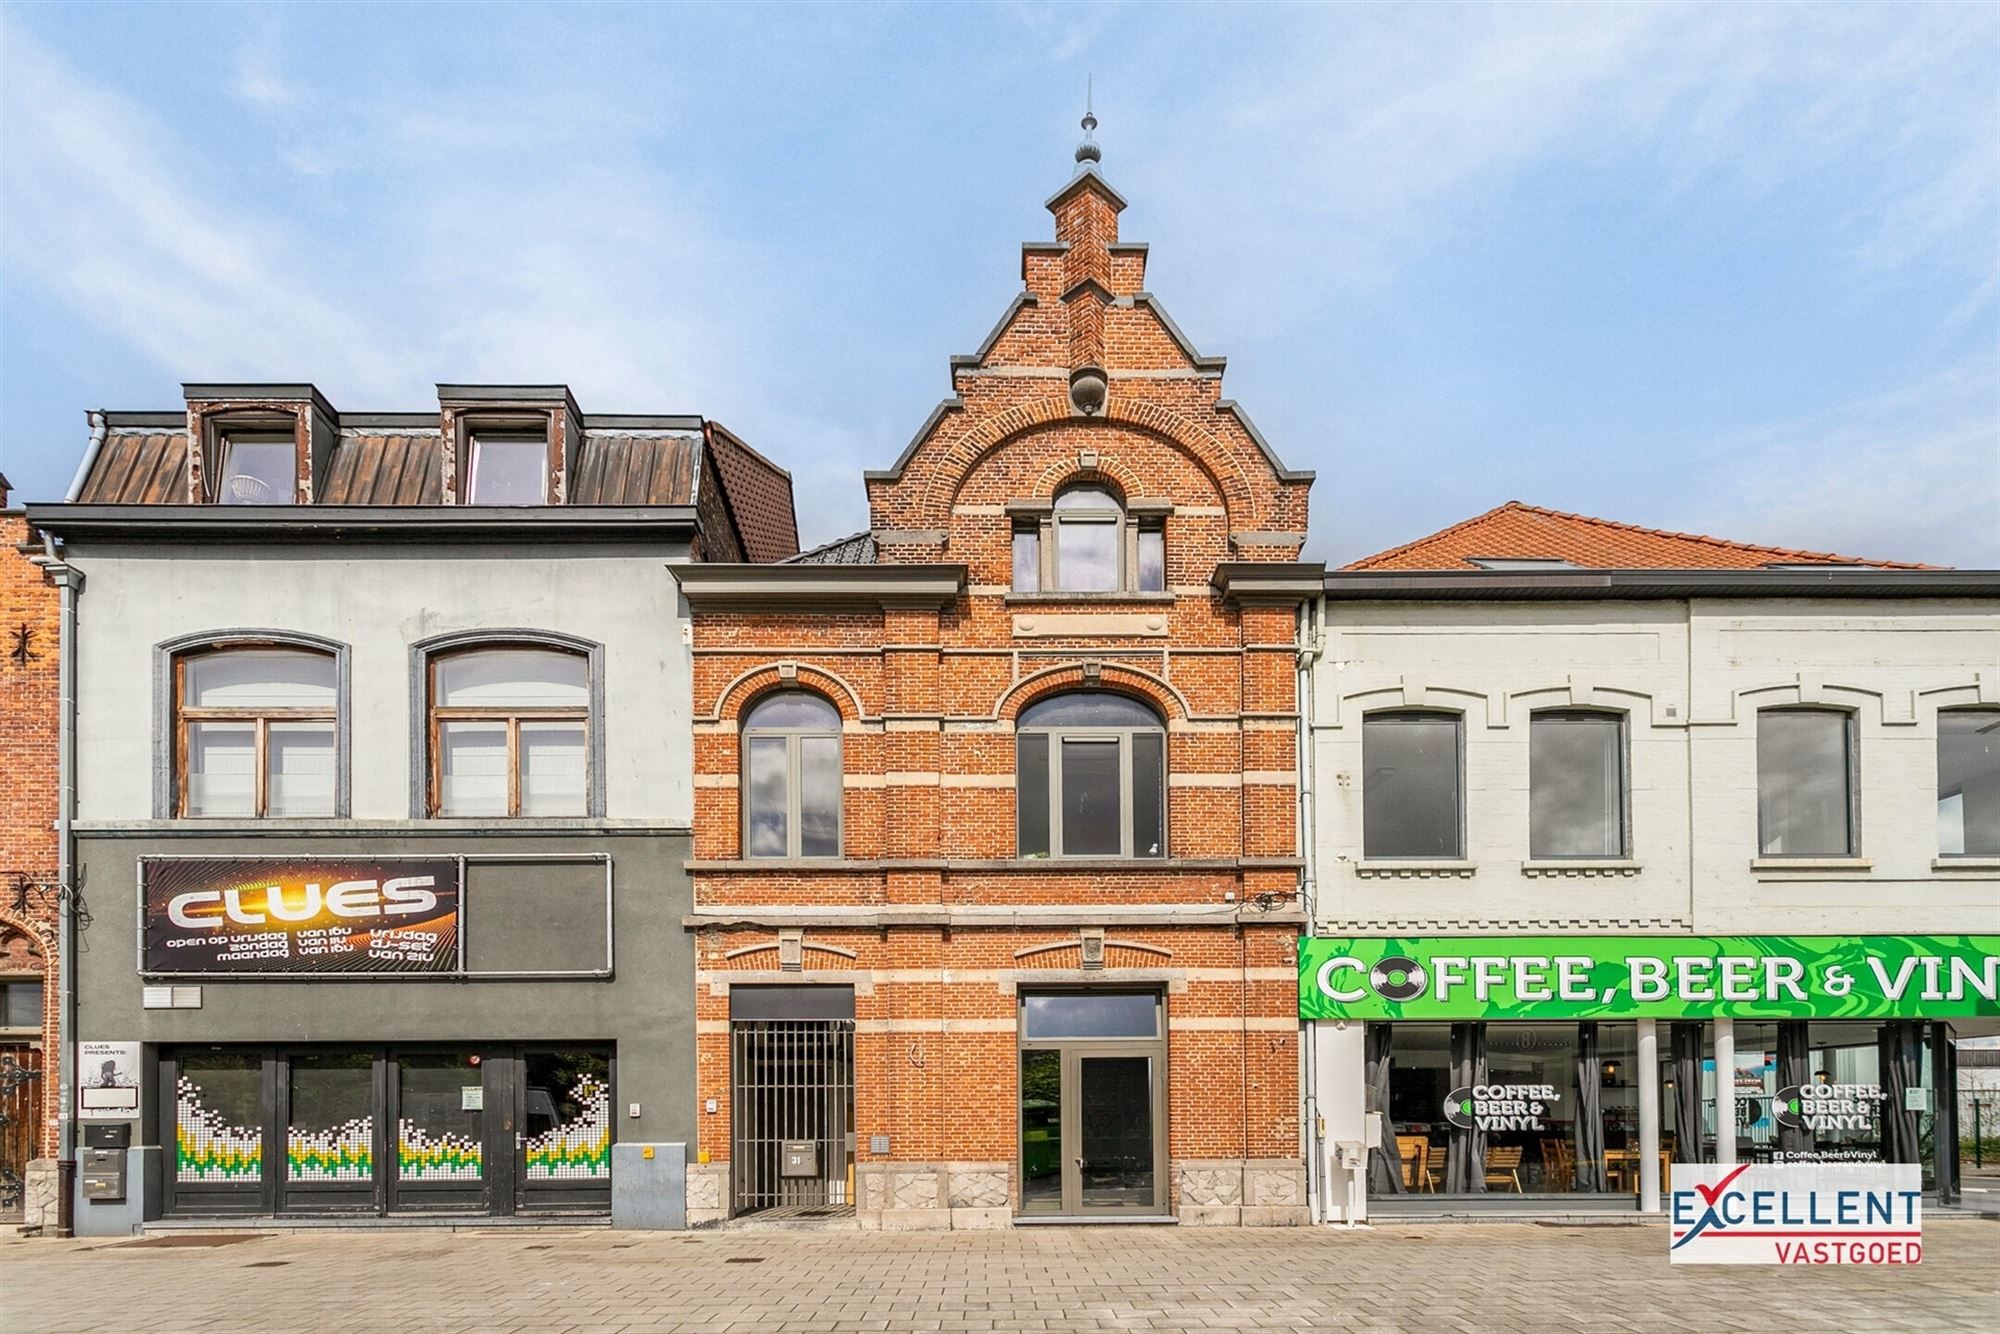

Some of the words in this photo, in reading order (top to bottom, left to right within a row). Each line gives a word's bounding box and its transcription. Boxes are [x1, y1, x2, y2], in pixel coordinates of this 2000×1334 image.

[167, 875, 437, 928] CLUES
[166, 938, 206, 948] open
[208, 935, 228, 946] op
[230, 931, 288, 943] vrijdag
[296, 929, 327, 938] van
[229, 940, 289, 951] zondag
[297, 937, 328, 946] van
[370, 928, 437, 944] vrijdag
[217, 949, 289, 961] maandag
[298, 945, 329, 955] van
[368, 949, 404, 960] van
[1316, 956, 1618, 1004] COFFEE,
[1625, 956, 1808, 1001] BEER
[1823, 965, 1856, 997] &
[1472, 1084, 1560, 1101] COFFEE,
[1799, 1083, 1888, 1100] COFFEE,
[1474, 1100, 1529, 1115] BEER
[1530, 1101, 1544, 1115] &
[1801, 1100, 1856, 1115] BEER
[1857, 1101, 1871, 1114] &
[1474, 1115, 1545, 1131] VINYL
[1802, 1115, 1872, 1130] VINYL
[791, 1156, 801, 1165] 31
